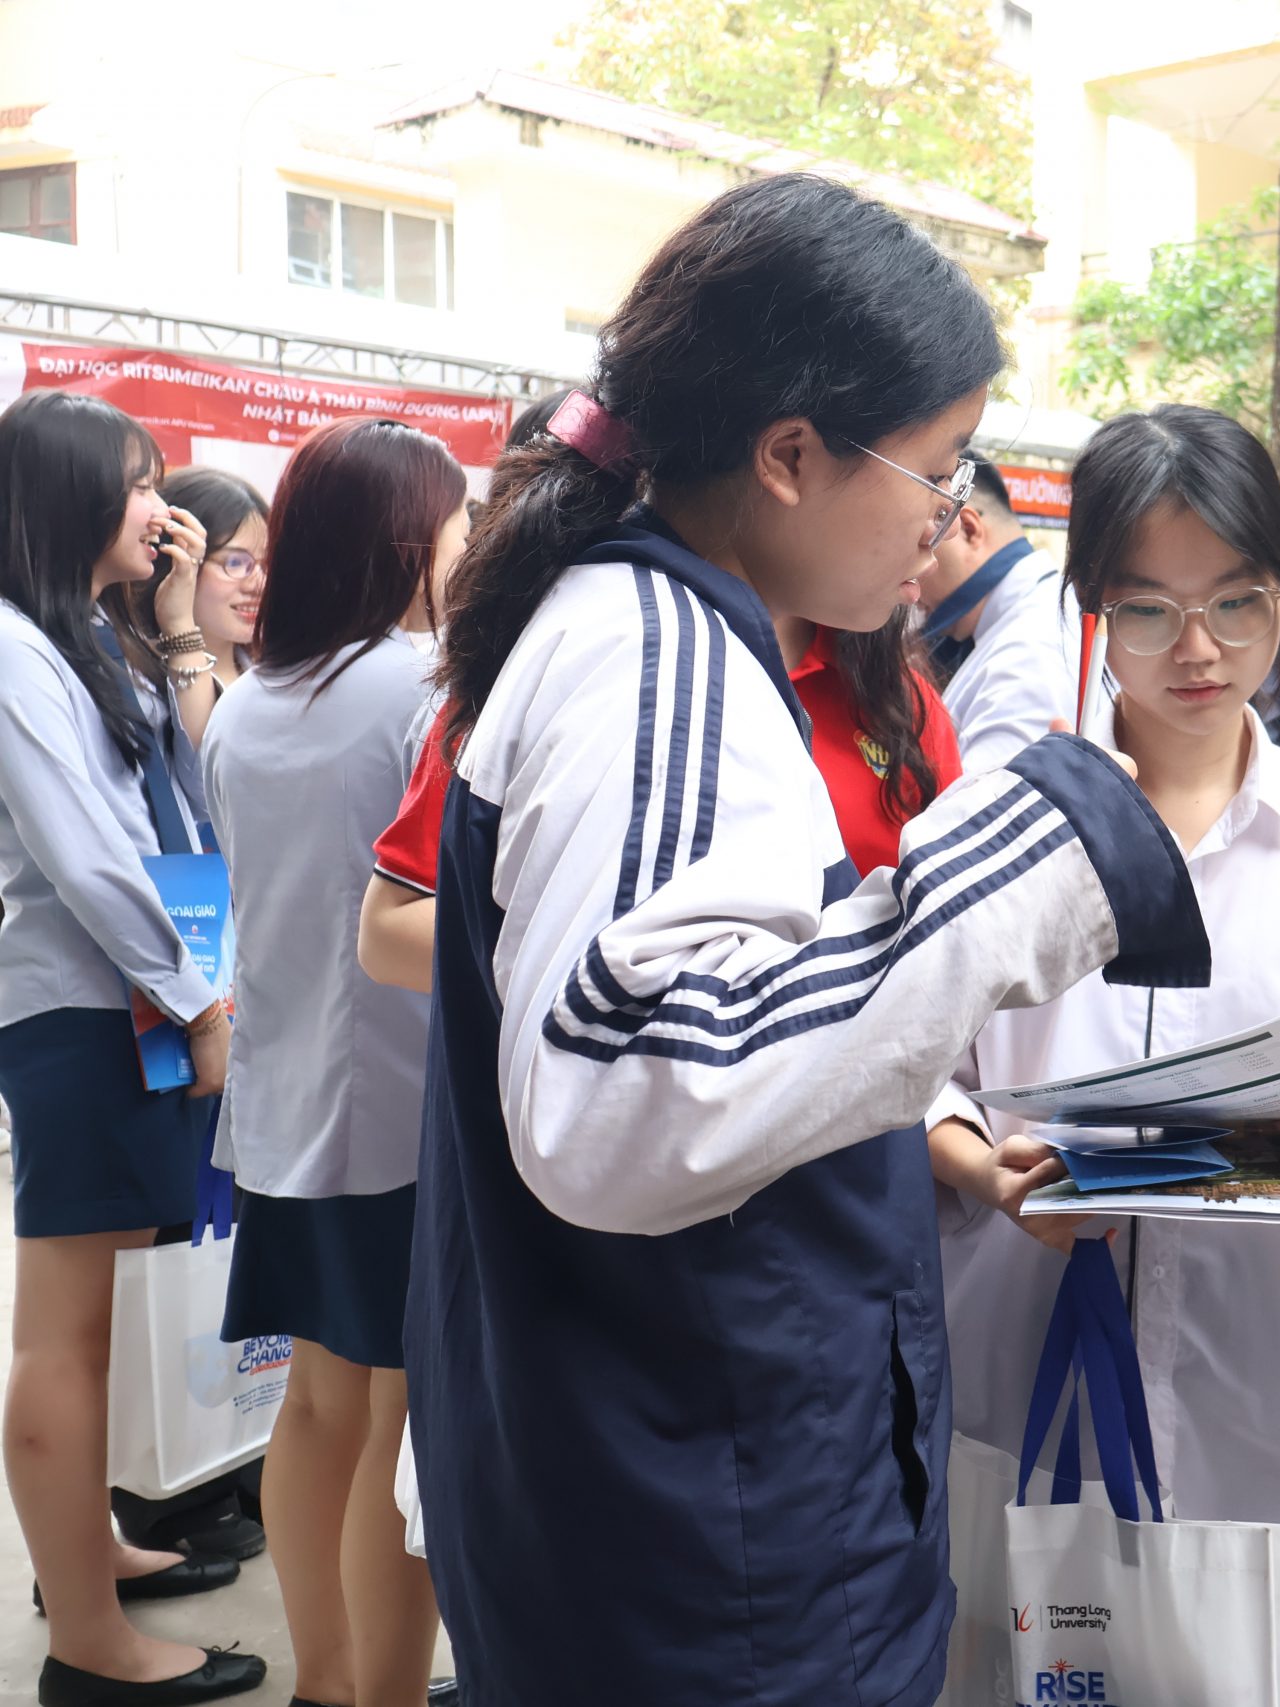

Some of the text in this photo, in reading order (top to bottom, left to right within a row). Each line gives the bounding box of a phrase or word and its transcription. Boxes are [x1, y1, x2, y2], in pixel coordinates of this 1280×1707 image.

[38, 356, 74, 378] ĐẠI
[78, 359, 119, 380] HỌC
[122, 362, 250, 394] RITSUMEIKAN
[1047, 1605, 1087, 1618] Thang
[1088, 1603, 1111, 1621] Long
[1050, 1617, 1106, 1632] University
[1035, 1669, 1106, 1702] RISE
